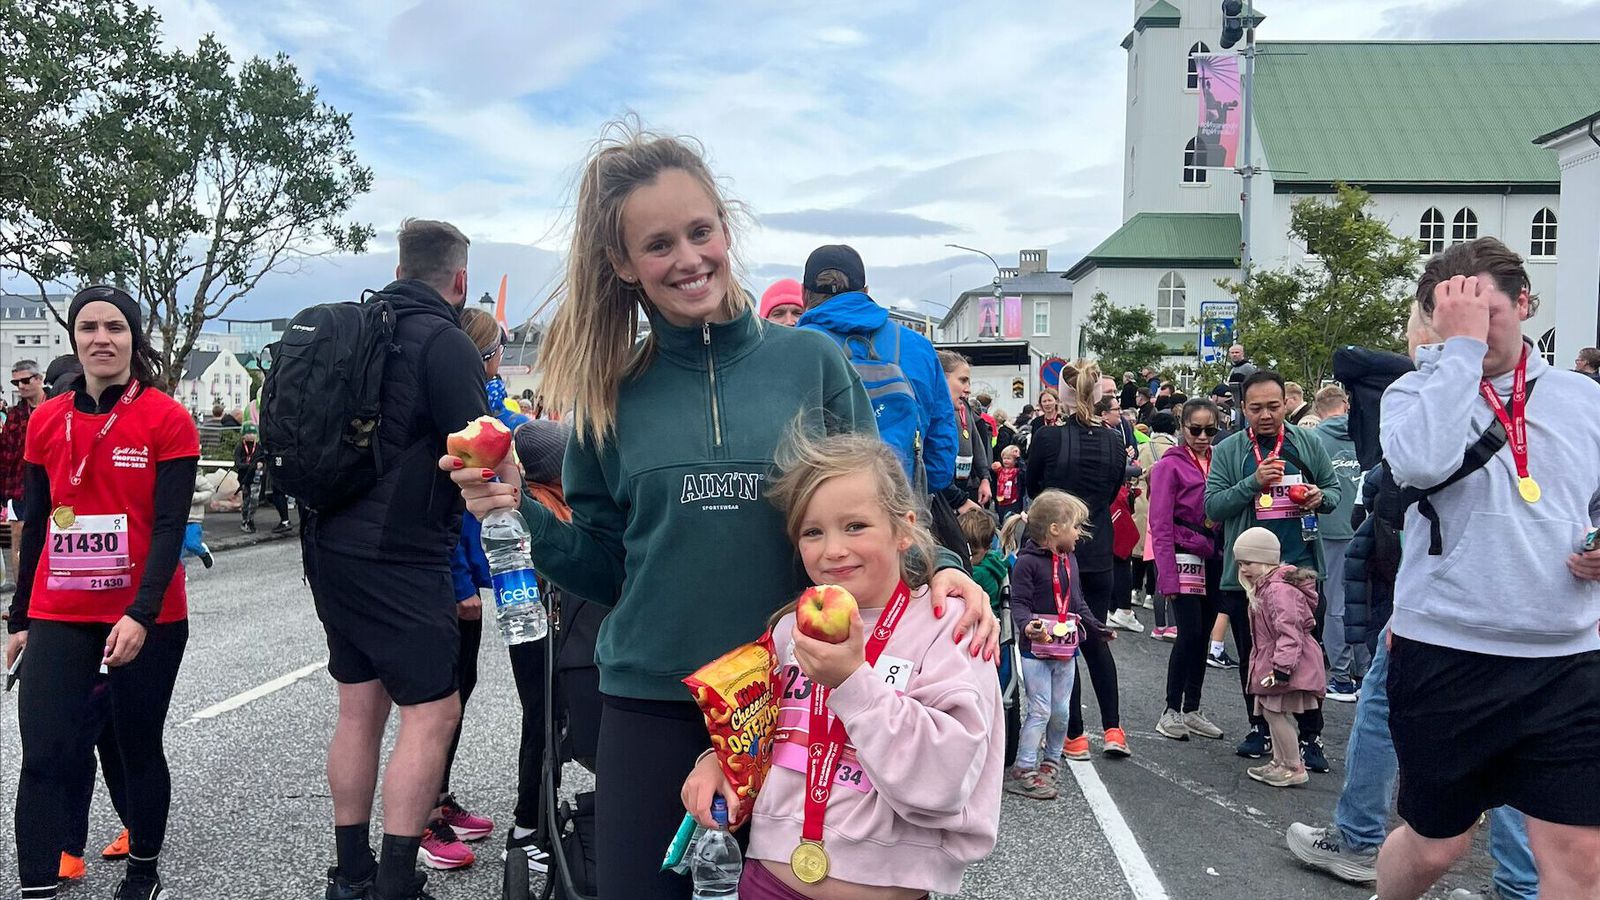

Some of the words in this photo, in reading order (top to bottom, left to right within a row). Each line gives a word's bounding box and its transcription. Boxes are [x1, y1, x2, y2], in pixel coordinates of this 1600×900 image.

[1331, 460, 1360, 469] Escap
[681, 473, 759, 504] AIM'N
[1270, 486, 1291, 497] 193
[53, 533, 118, 553] 21430
[1177, 564, 1201, 574] 0287
[91, 578, 123, 588] 21430
[500, 581, 538, 604] ícela
[783, 666, 812, 700] 23
[1312, 840, 1340, 853] HOKA
